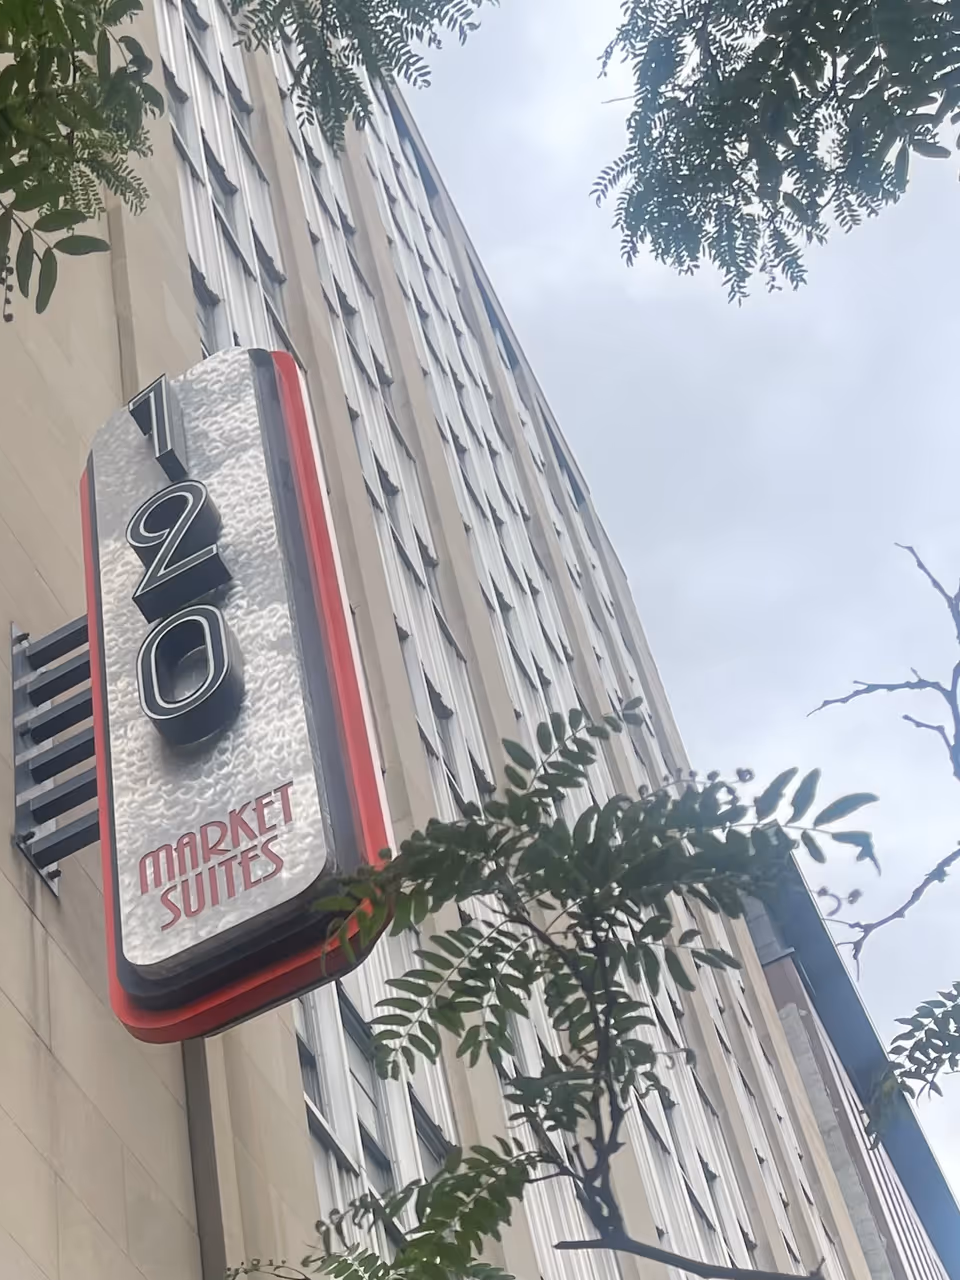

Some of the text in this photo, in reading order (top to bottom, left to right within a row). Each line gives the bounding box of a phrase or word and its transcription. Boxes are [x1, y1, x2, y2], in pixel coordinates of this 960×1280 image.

[126, 374, 240, 738] 120
[138, 781, 294, 896] MARKET
[161, 834, 284, 931] SUITES
